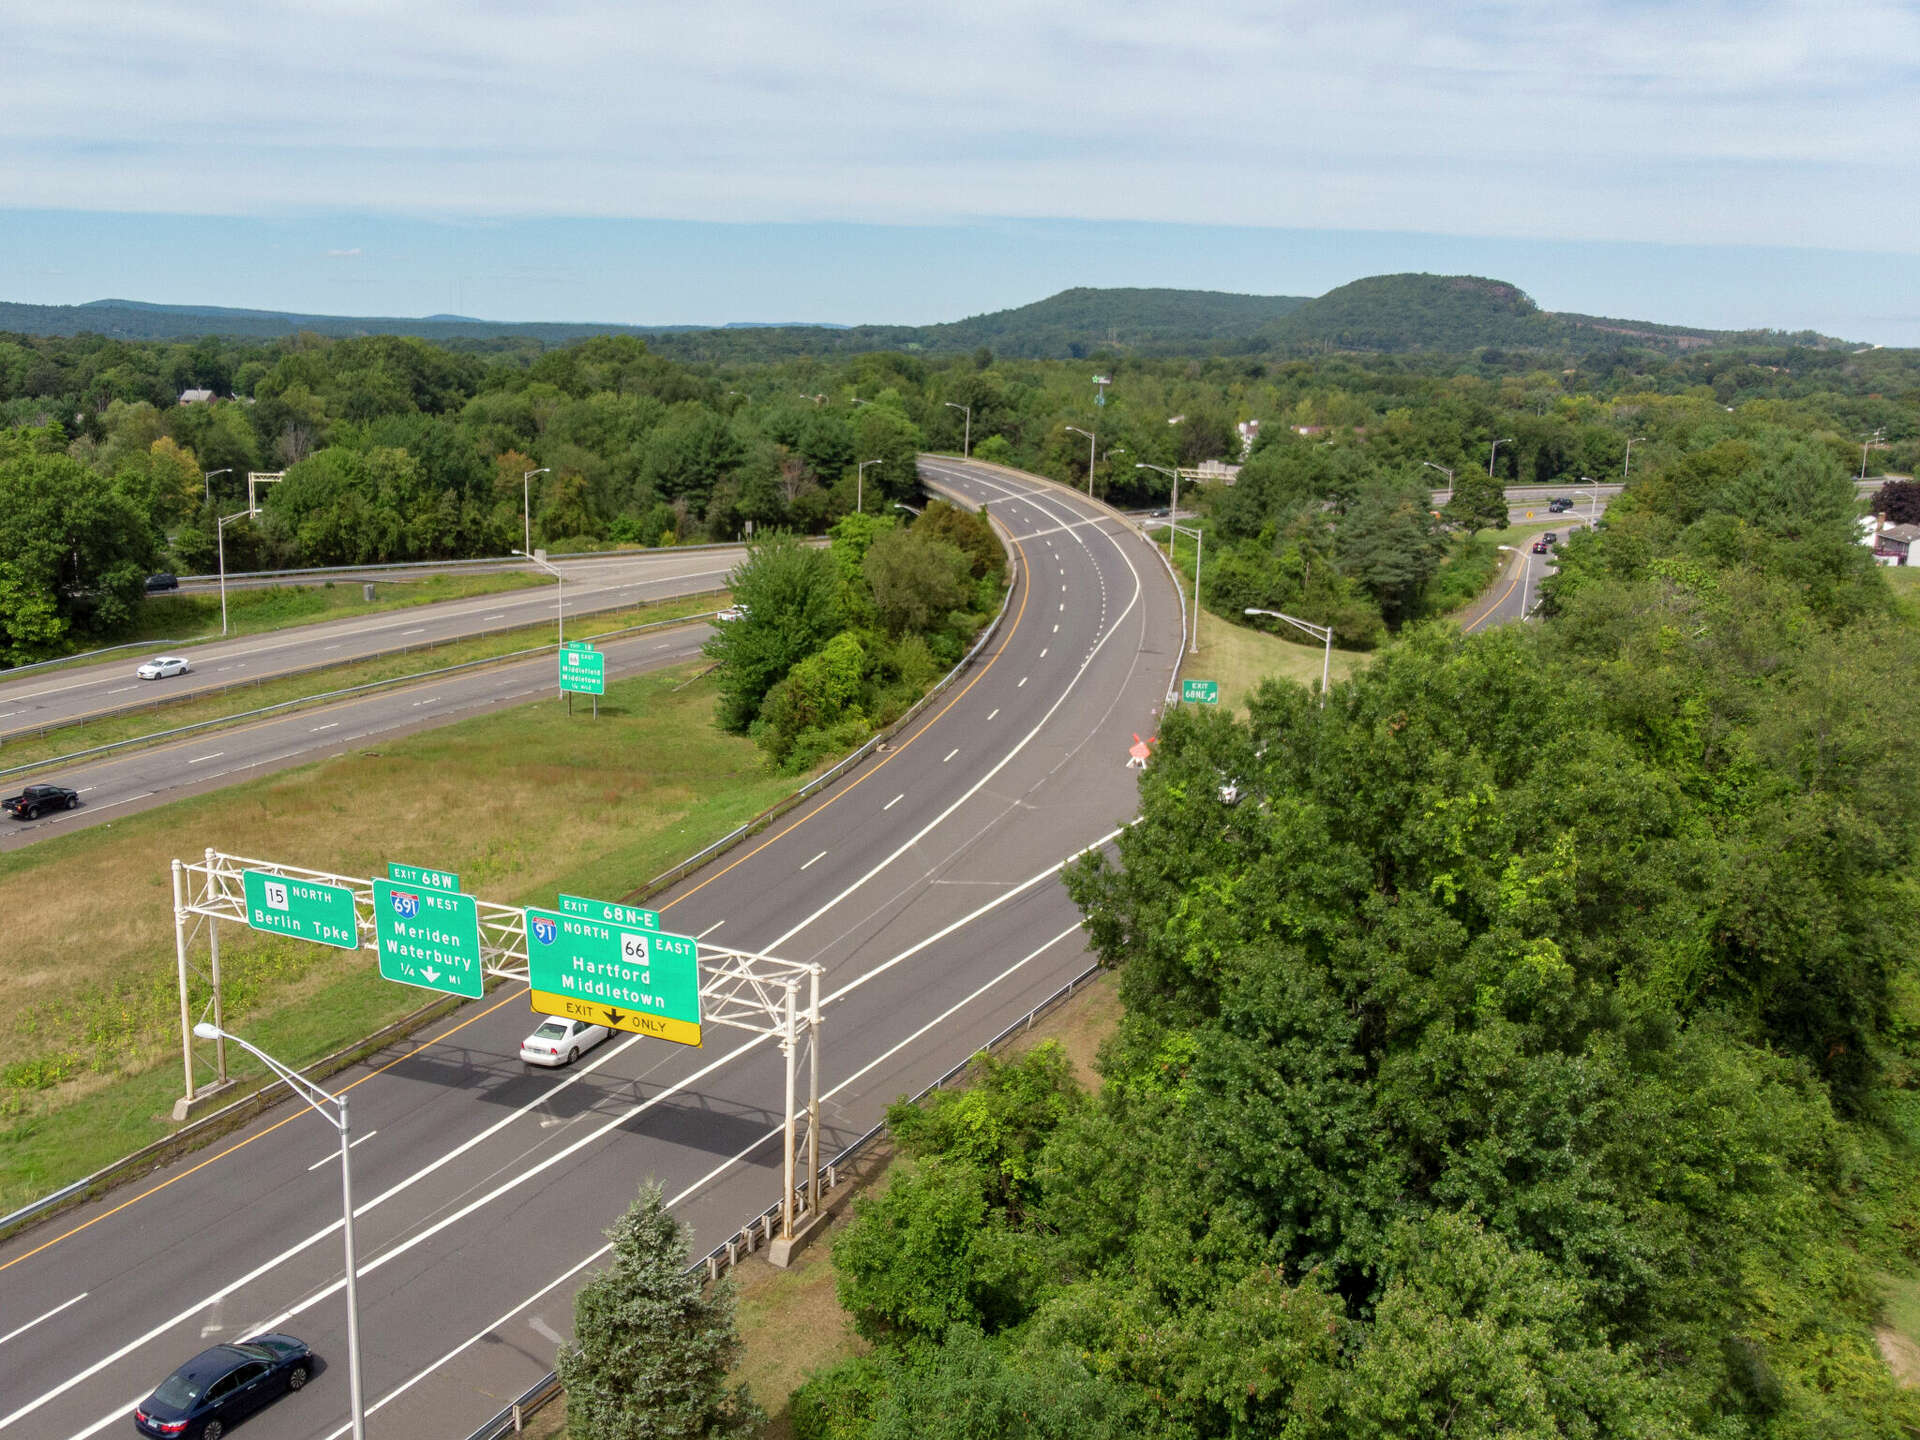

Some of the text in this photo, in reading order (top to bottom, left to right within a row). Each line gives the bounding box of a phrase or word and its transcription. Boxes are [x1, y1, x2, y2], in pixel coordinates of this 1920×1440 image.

[562, 674, 601, 685] Middletown
[563, 666, 600, 676] Middlefield
[394, 868, 452, 889] EXIT 68W
[268, 886, 332, 904] 15 NORTH
[394, 895, 459, 915] 691 WEST
[254, 909, 349, 942] Berlin Tpke
[563, 900, 654, 927] EXIT 68N-E
[394, 921, 461, 947] Meriden
[535, 922, 691, 958] 91 NORTH 66 EAST
[386, 939, 471, 972] Waterbury
[400, 962, 461, 985] 1/4 MI
[573, 956, 651, 985] Hartford
[561, 974, 665, 1009] Middletown
[566, 1002, 666, 1033] EXIT ONLY
